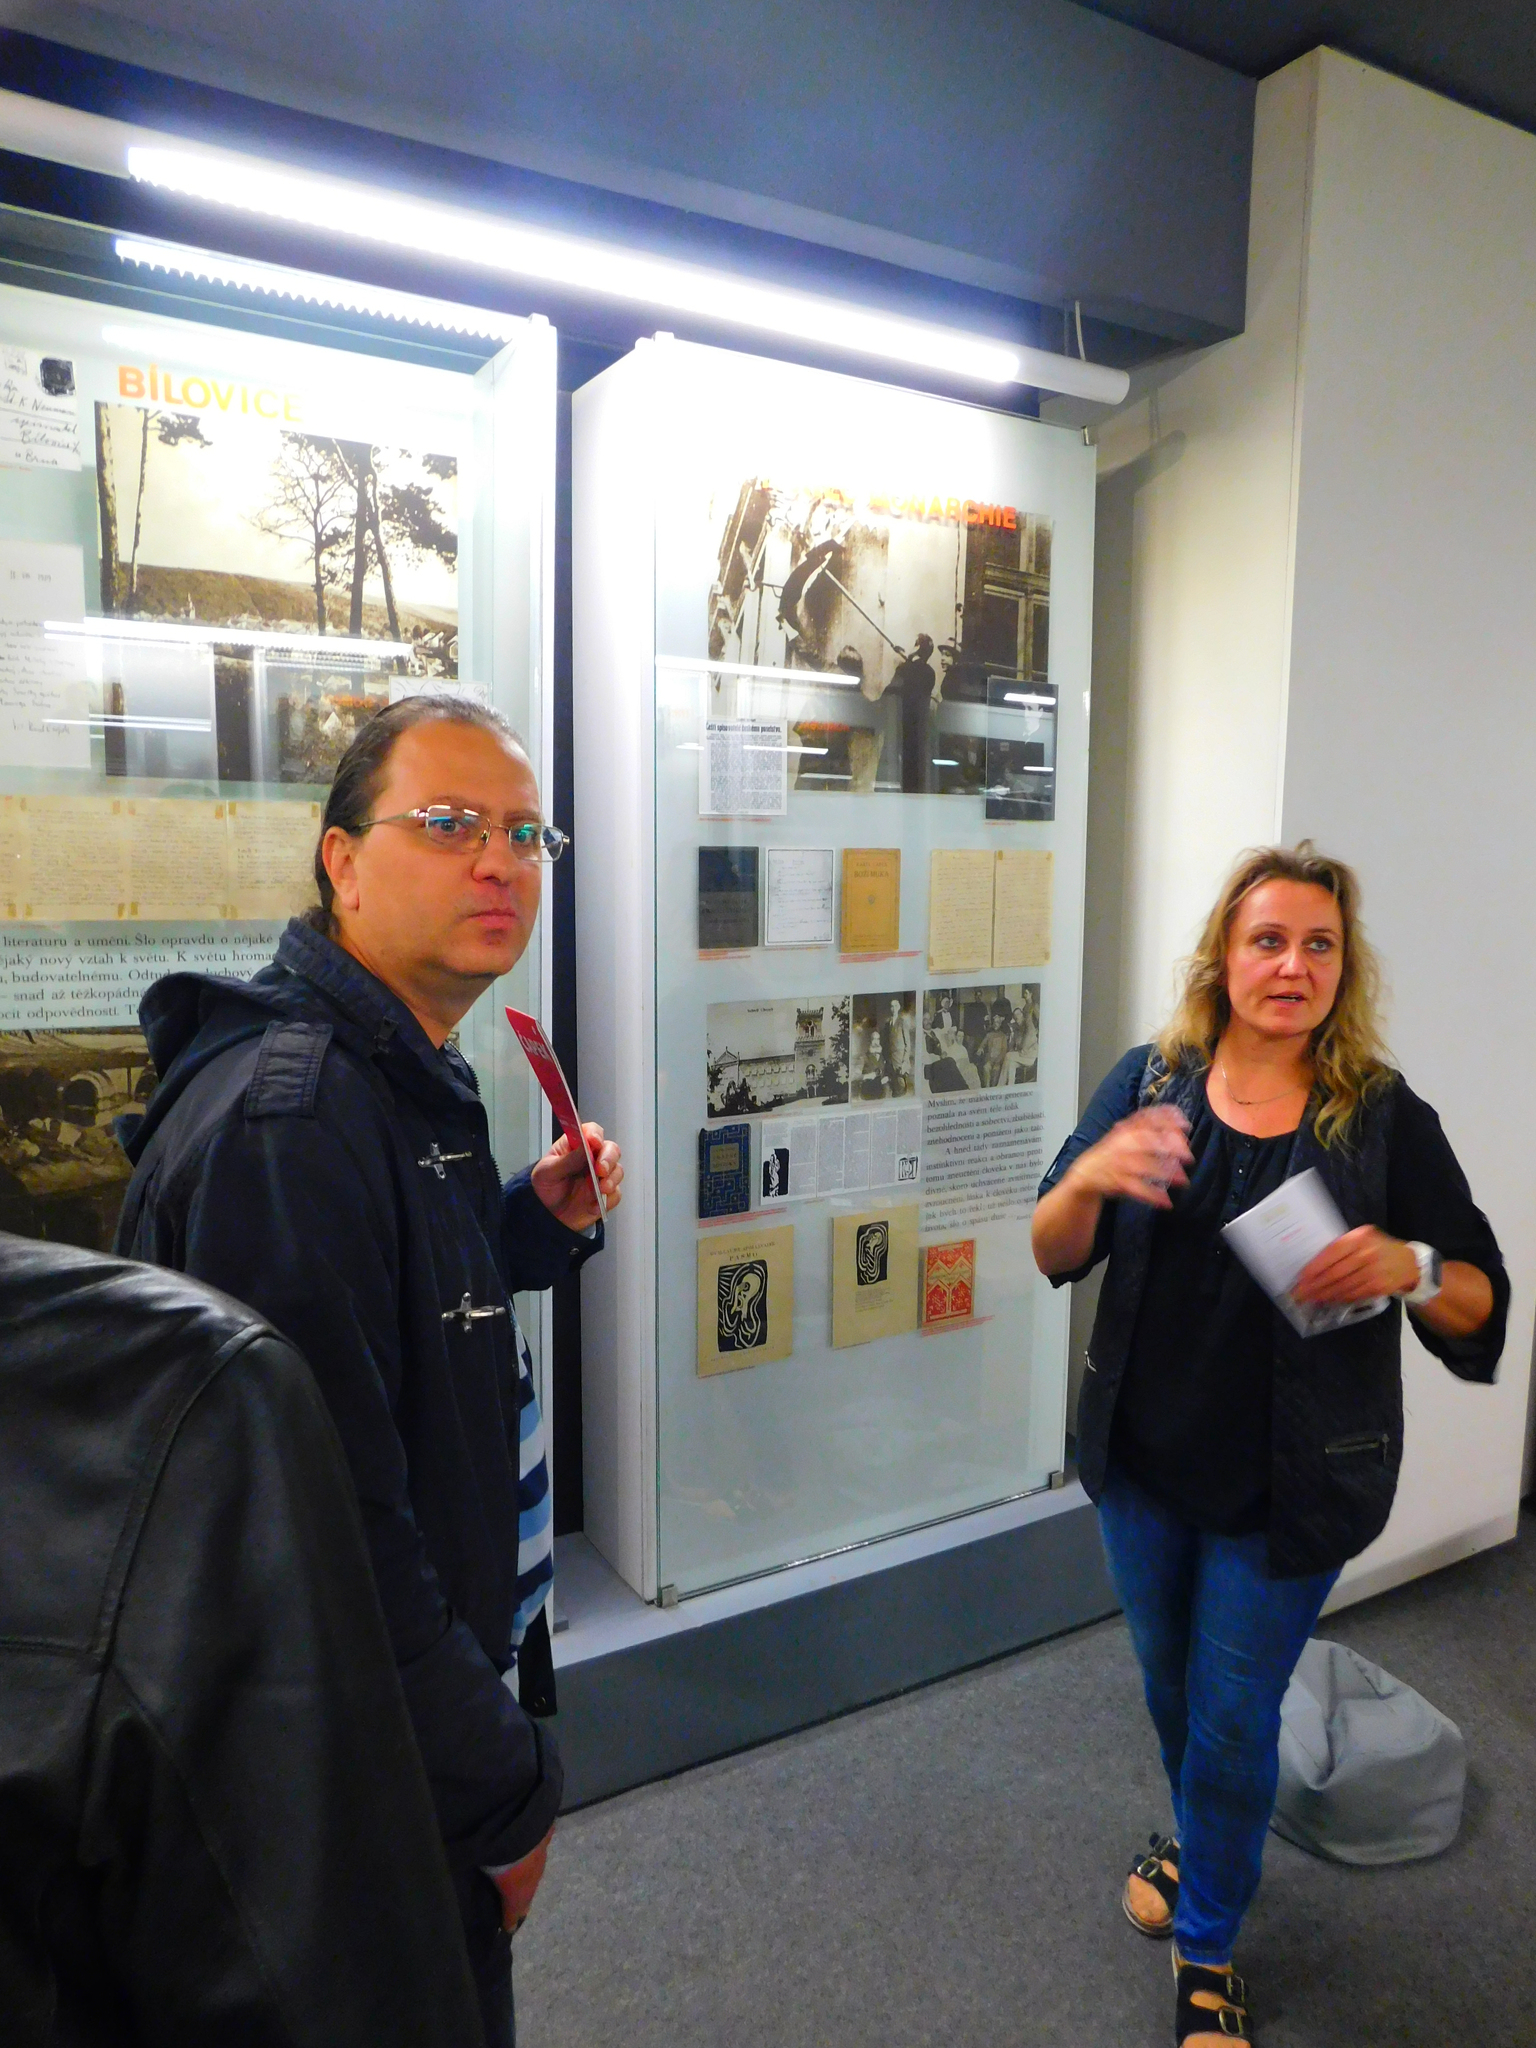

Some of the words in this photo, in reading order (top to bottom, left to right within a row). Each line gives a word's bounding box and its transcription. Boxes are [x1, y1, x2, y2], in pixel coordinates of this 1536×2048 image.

[118, 362, 303, 423] BÍLOVICE
[3, 935, 67, 947] literaturu
[74, 938, 81, 947] a
[134, 932, 156, 946] Šlo
[161, 933, 215, 949] opravdu
[220, 936, 228, 945] o
[233, 932, 273, 947] nějaké
[40, 954, 72, 970] nový
[79, 952, 114, 965] vztah
[120, 952, 127, 964] k
[133, 953, 169, 965] světu.
[177, 951, 187, 962] K
[194, 952, 227, 963] světu
[11, 969, 123, 984] budovatelnému.
[13, 988, 44, 1001] snad
[51, 988, 66, 1000] až
